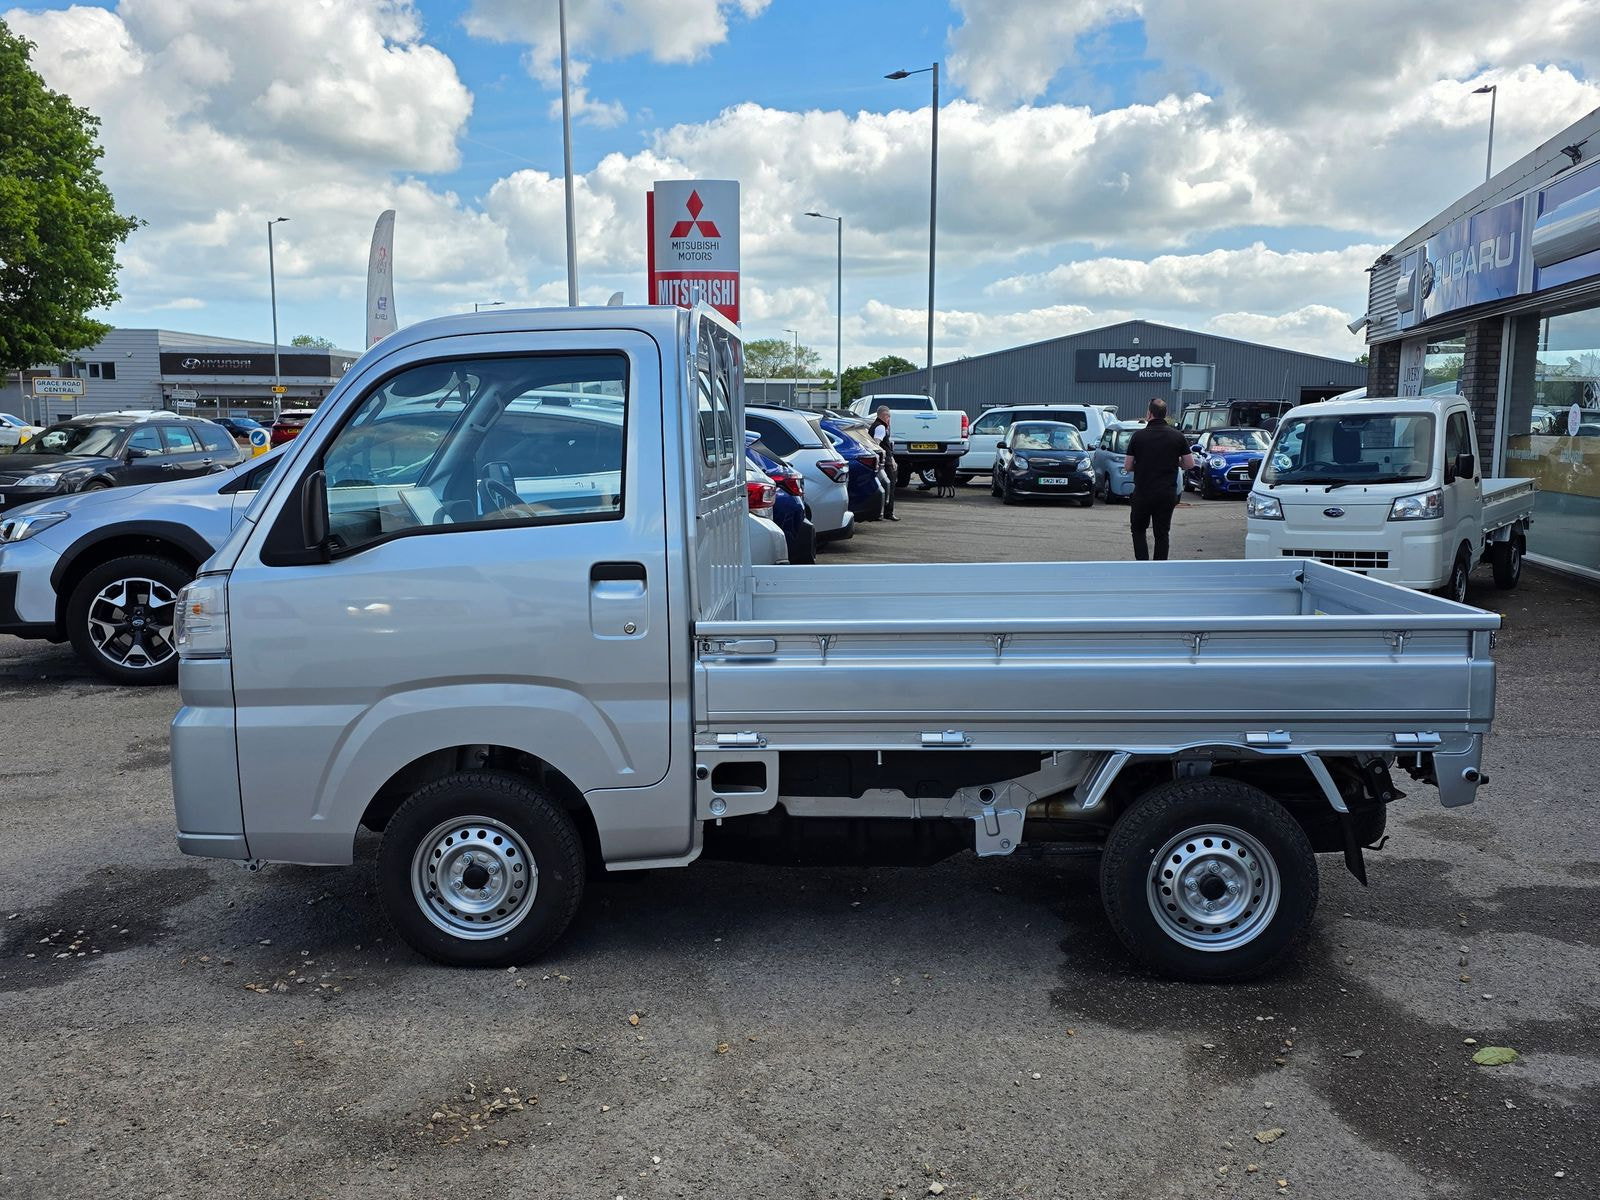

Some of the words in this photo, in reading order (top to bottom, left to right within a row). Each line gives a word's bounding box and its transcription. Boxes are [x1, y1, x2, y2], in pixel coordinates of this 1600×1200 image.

[672, 241, 719, 250] MITSUBISHI
[678, 252, 713, 261] MOTORS
[1434, 232, 1515, 284] SUBARU
[202, 359, 251, 368] HYUNDAI
[1098, 353, 1173, 371] Magnet
[1139, 370, 1172, 378] Kitchens
